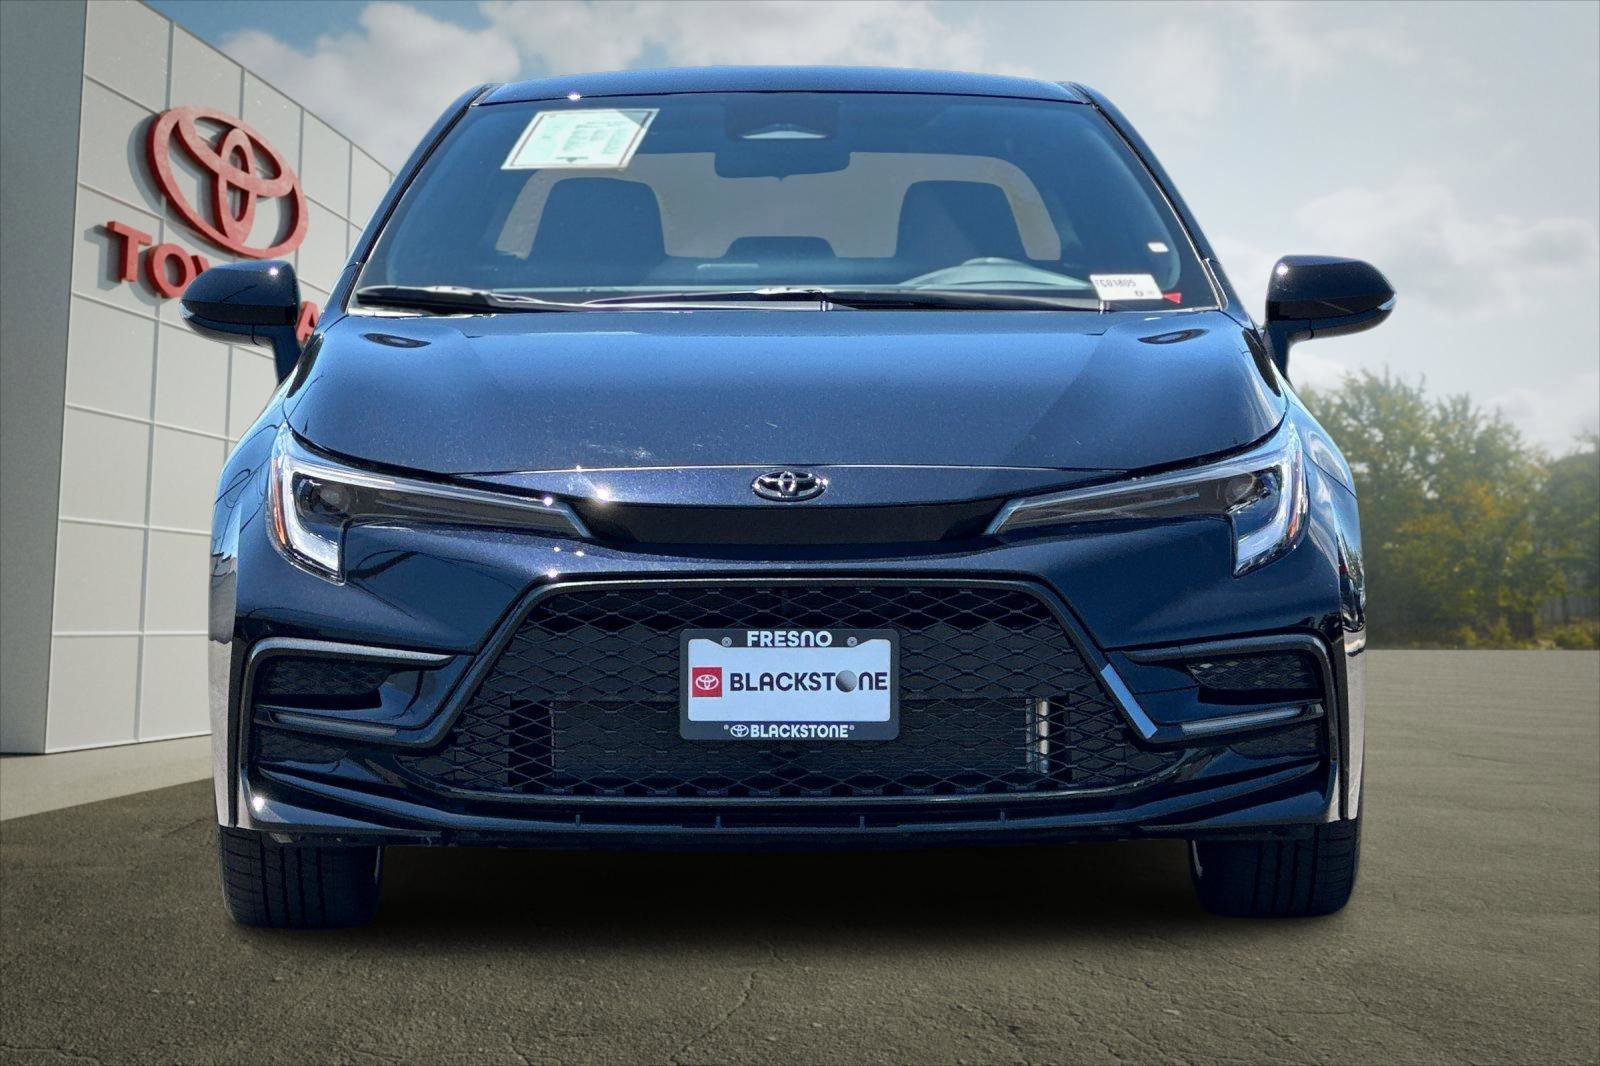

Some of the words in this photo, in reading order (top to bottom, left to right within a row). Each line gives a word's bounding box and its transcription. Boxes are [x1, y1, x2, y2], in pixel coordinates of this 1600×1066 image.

[107, 221, 318, 342] TOA
[747, 630, 833, 647] FRESNO
[730, 671, 888, 692] BLACKSTONE
[751, 724, 849, 738] BLACKSTONE
